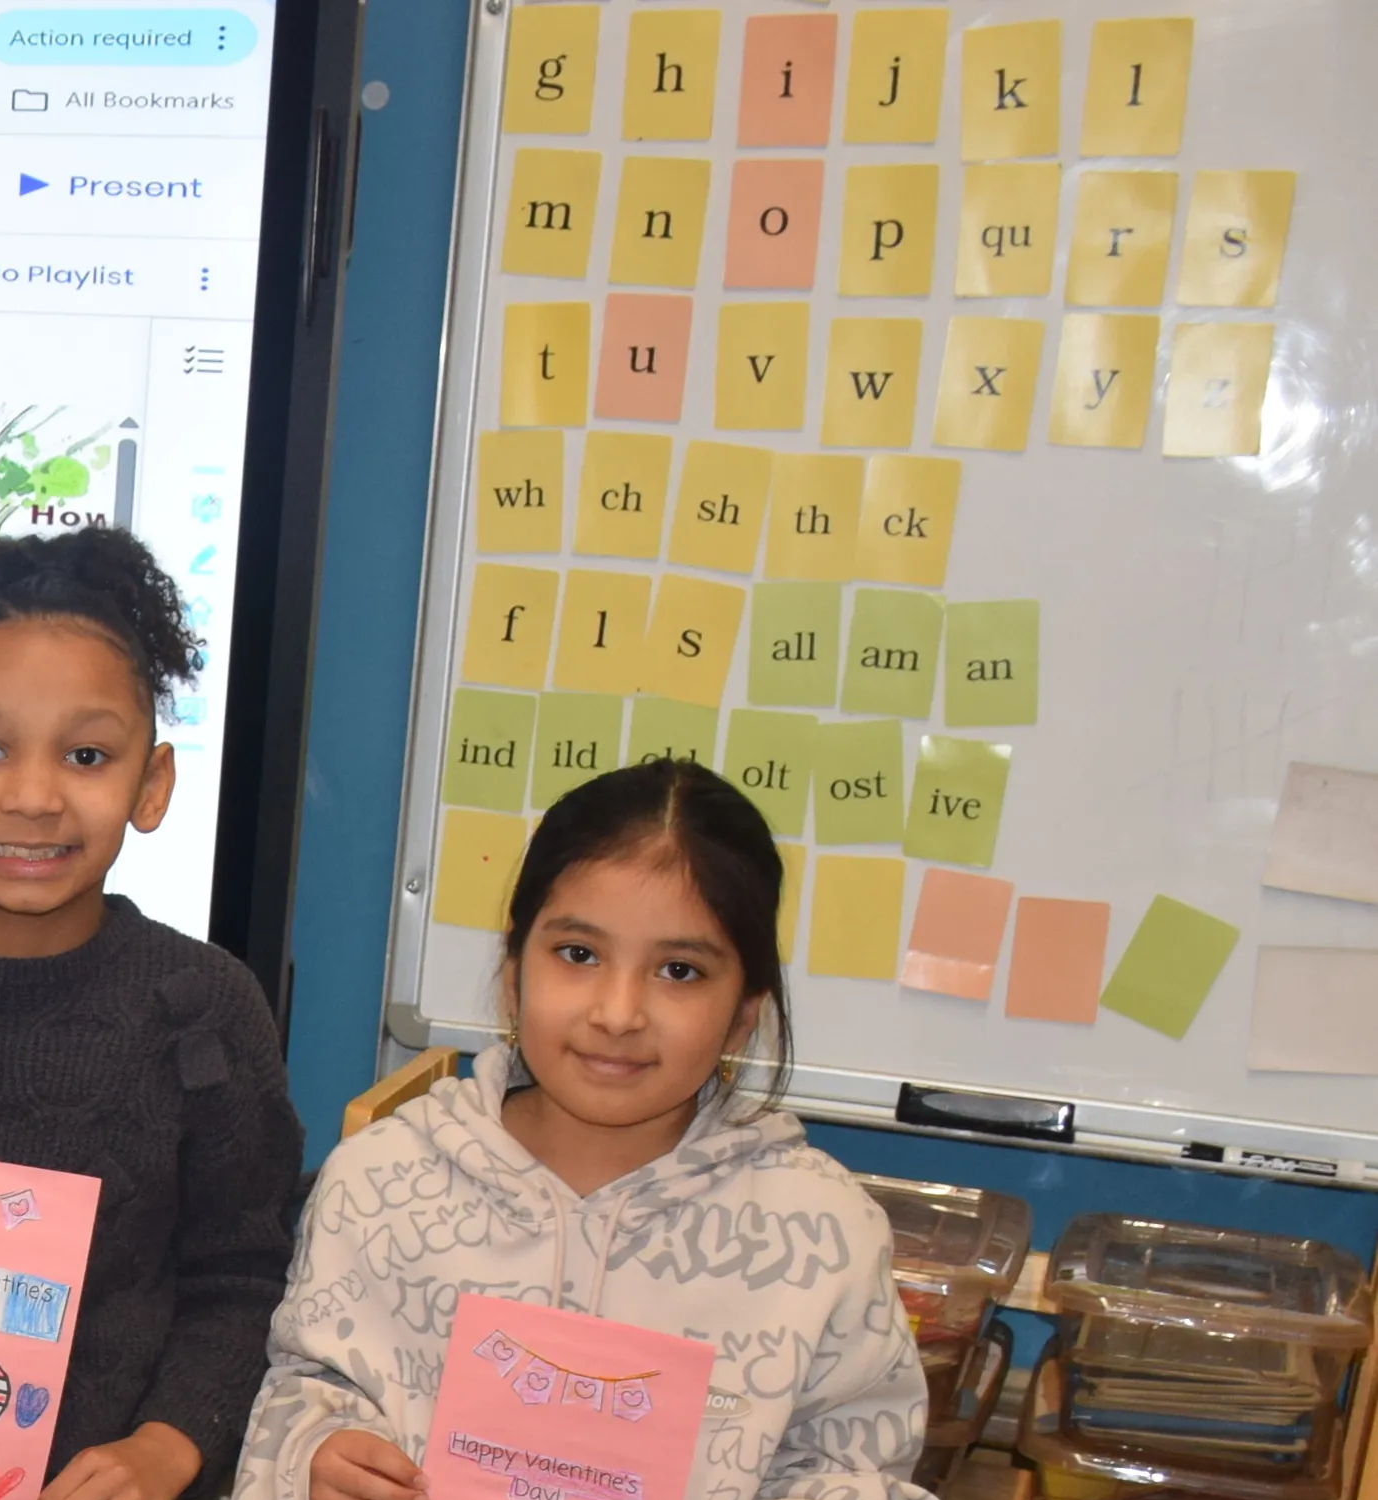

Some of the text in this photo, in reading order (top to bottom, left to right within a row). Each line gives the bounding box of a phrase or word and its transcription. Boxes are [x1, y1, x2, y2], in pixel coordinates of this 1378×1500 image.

[10, 29, 193, 50] Action required
[65, 90, 235, 110] All Bookmarks
[534, 51, 1029, 111] g h i j k
[69, 175, 203, 199] Present
[524, 198, 1248, 262] m n o p qu r s
[28, 265, 135, 292] Playlist
[537, 342, 1121, 410] t u v w x y
[492, 478, 931, 540] wh ch sh th ck
[500, 604, 1014, 682] f s all am an
[457, 736, 983, 820] ind ild olt ost ive
[449, 1430, 640, 1496] Happy Valentine's
